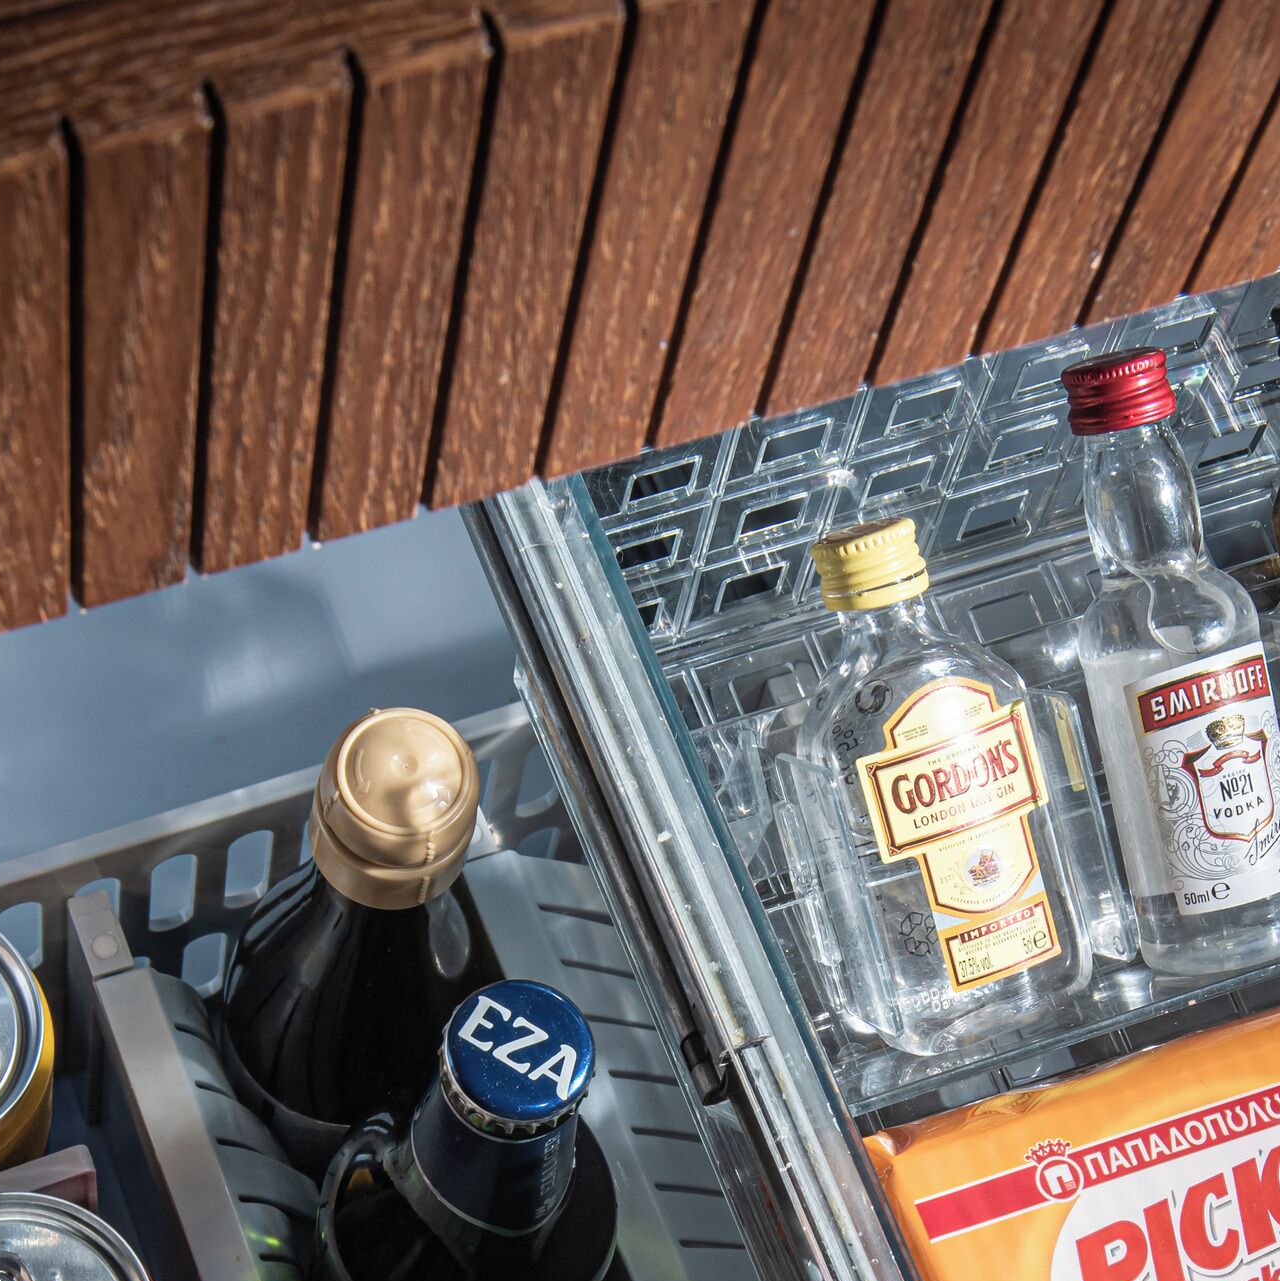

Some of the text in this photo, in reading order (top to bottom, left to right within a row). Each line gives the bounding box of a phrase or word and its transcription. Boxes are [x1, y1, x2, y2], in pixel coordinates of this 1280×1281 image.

[891, 739, 1019, 815] GORDON'S
[913, 802, 967, 829] LONDON
[996, 782, 1015, 799] GIN
[1213, 796, 1265, 819] VODKA
[1184, 889, 1210, 906] 50ml
[963, 909, 1032, 942] IMPORTED
[456, 994, 580, 1100] EZA
